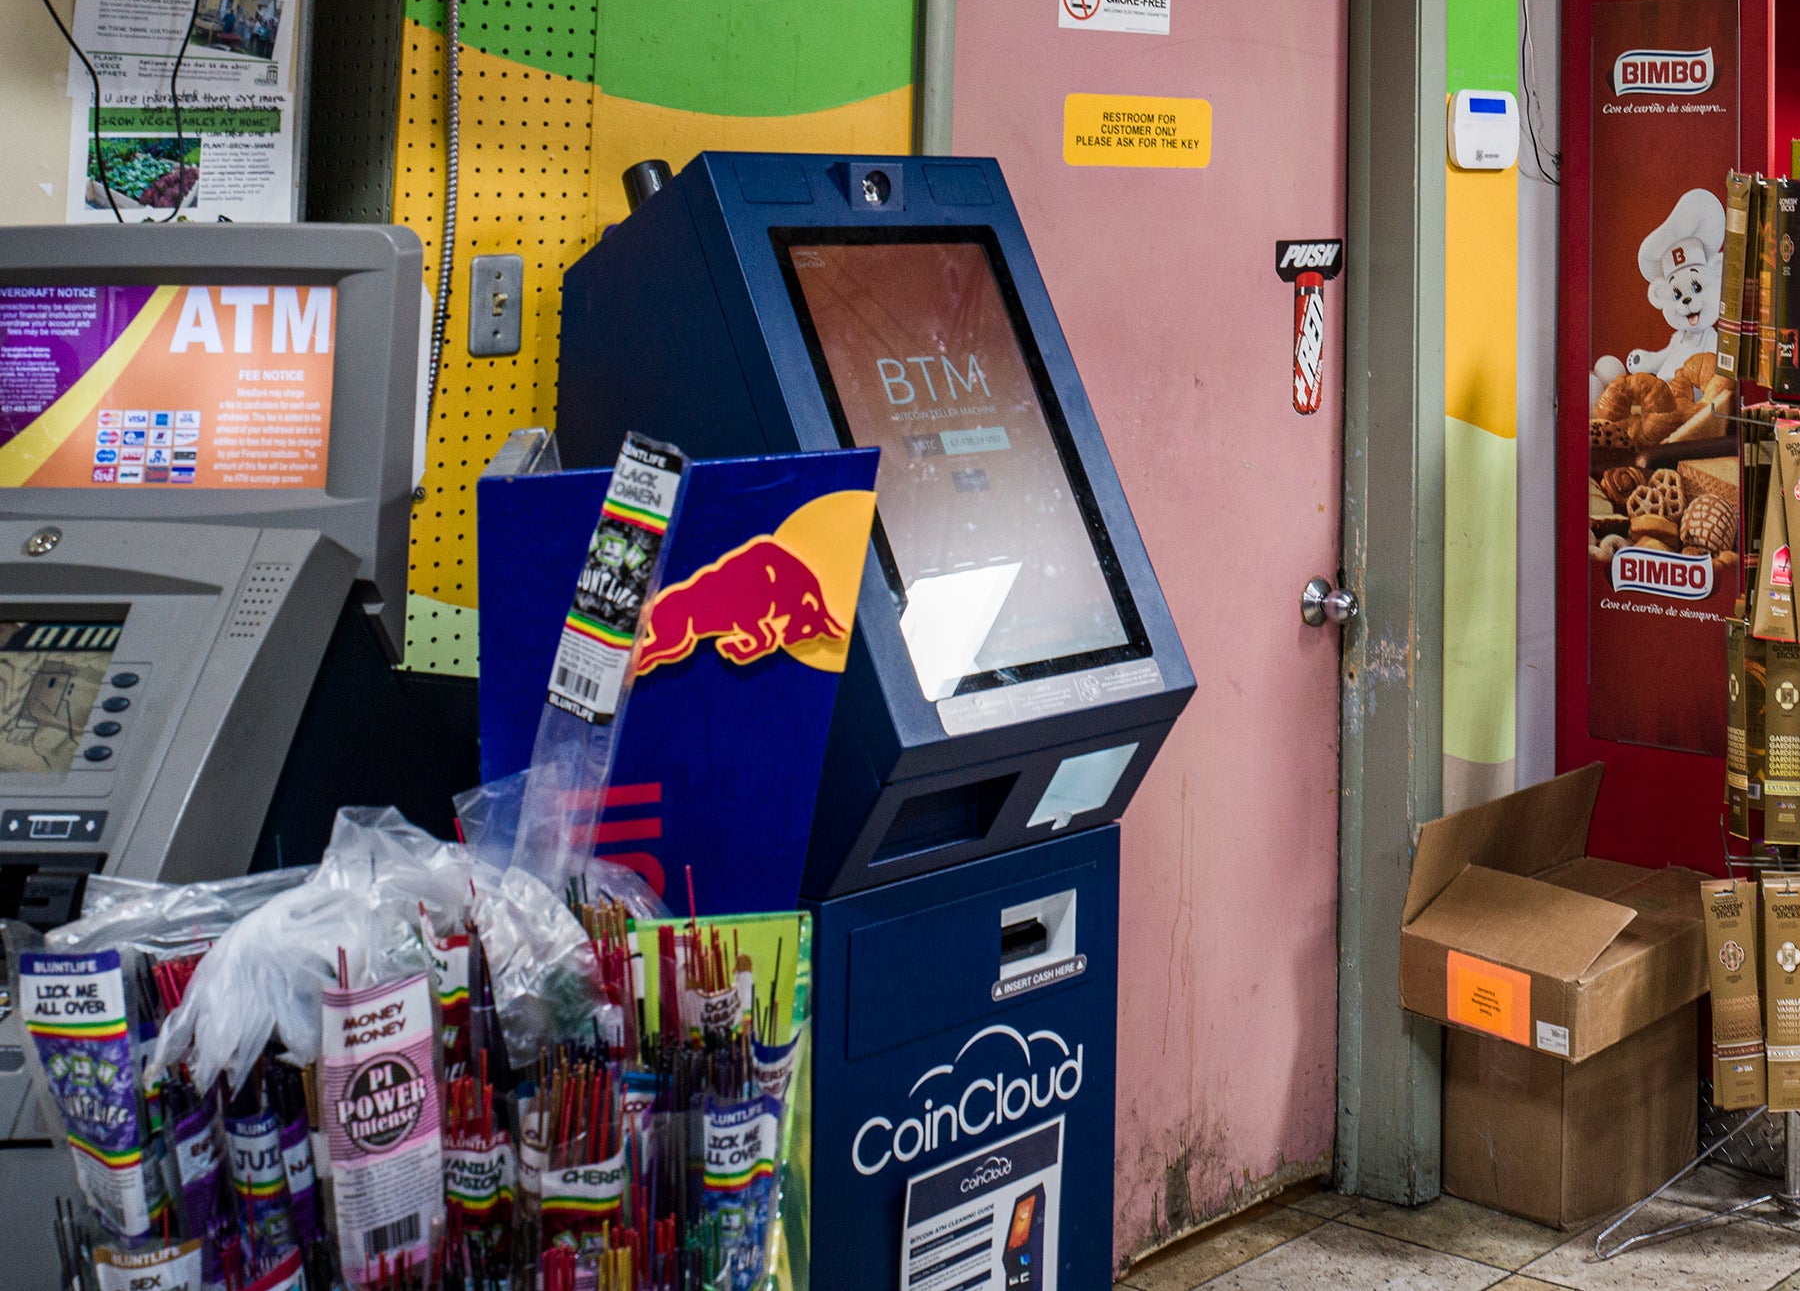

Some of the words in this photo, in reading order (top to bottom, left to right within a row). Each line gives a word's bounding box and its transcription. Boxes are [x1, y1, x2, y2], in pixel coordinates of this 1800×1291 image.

[1622, 60, 1707, 84] BIMBO
[1602, 103, 1621, 114] Con
[101, 116, 135, 126] GROW
[140, 116, 216, 126] VEGETABLES
[221, 118, 234, 126] AT
[1103, 112, 1154, 123] RESTROOM
[1158, 114, 1176, 124] FOR
[1101, 125, 1151, 135] CUSTOMER
[1155, 126, 1177, 136] ONLY
[1076, 136, 1112, 147] PLEASE
[1116, 138, 1135, 147] ASK
[1139, 138, 1157, 148] FOR
[1162, 139, 1177, 148] THE
[1181, 139, 1199, 149] KEY
[1280, 244, 1340, 268] PUSH
[0, 288, 55, 297] VERDRAFT
[57, 288, 97, 297] NOTICE
[169, 287, 332, 353] ATM
[239, 369, 261, 381] FEE
[263, 369, 304, 381] NOTICE
[876, 354, 991, 405] BTM
[960, 406, 998, 417] MACHINE
[1620, 557, 1706, 589] BIMBO
[1600, 597, 1618, 610] Con
[1666, 603, 1676, 615] de
[1716, 911, 1740, 919] STICKS
[1776, 911, 1800, 919] STICKS
[33, 959, 97, 974] BLUNTLIFE
[1004, 975, 1032, 994] INSERT
[1033, 969, 1054, 988] CASH
[1054, 962, 1075, 981] HERE
[37, 985, 73, 1000] LICK
[76, 984, 98, 999] ME
[35, 1000, 64, 1015] ALL
[66, 998, 106, 1015] OVER
[343, 1001, 405, 1031] MONEY
[344, 1018, 407, 1048] MONEY
[369, 1064, 392, 1091] PI
[336, 1079, 426, 1125] POWER
[852, 1043, 1083, 1176] CoinCloud
[351, 1105, 418, 1140] Intense
[729, 1141, 762, 1165] OVER
[960, 1159, 1012, 1193] CoinCloud
[130, 1275, 162, 1291] SEX
